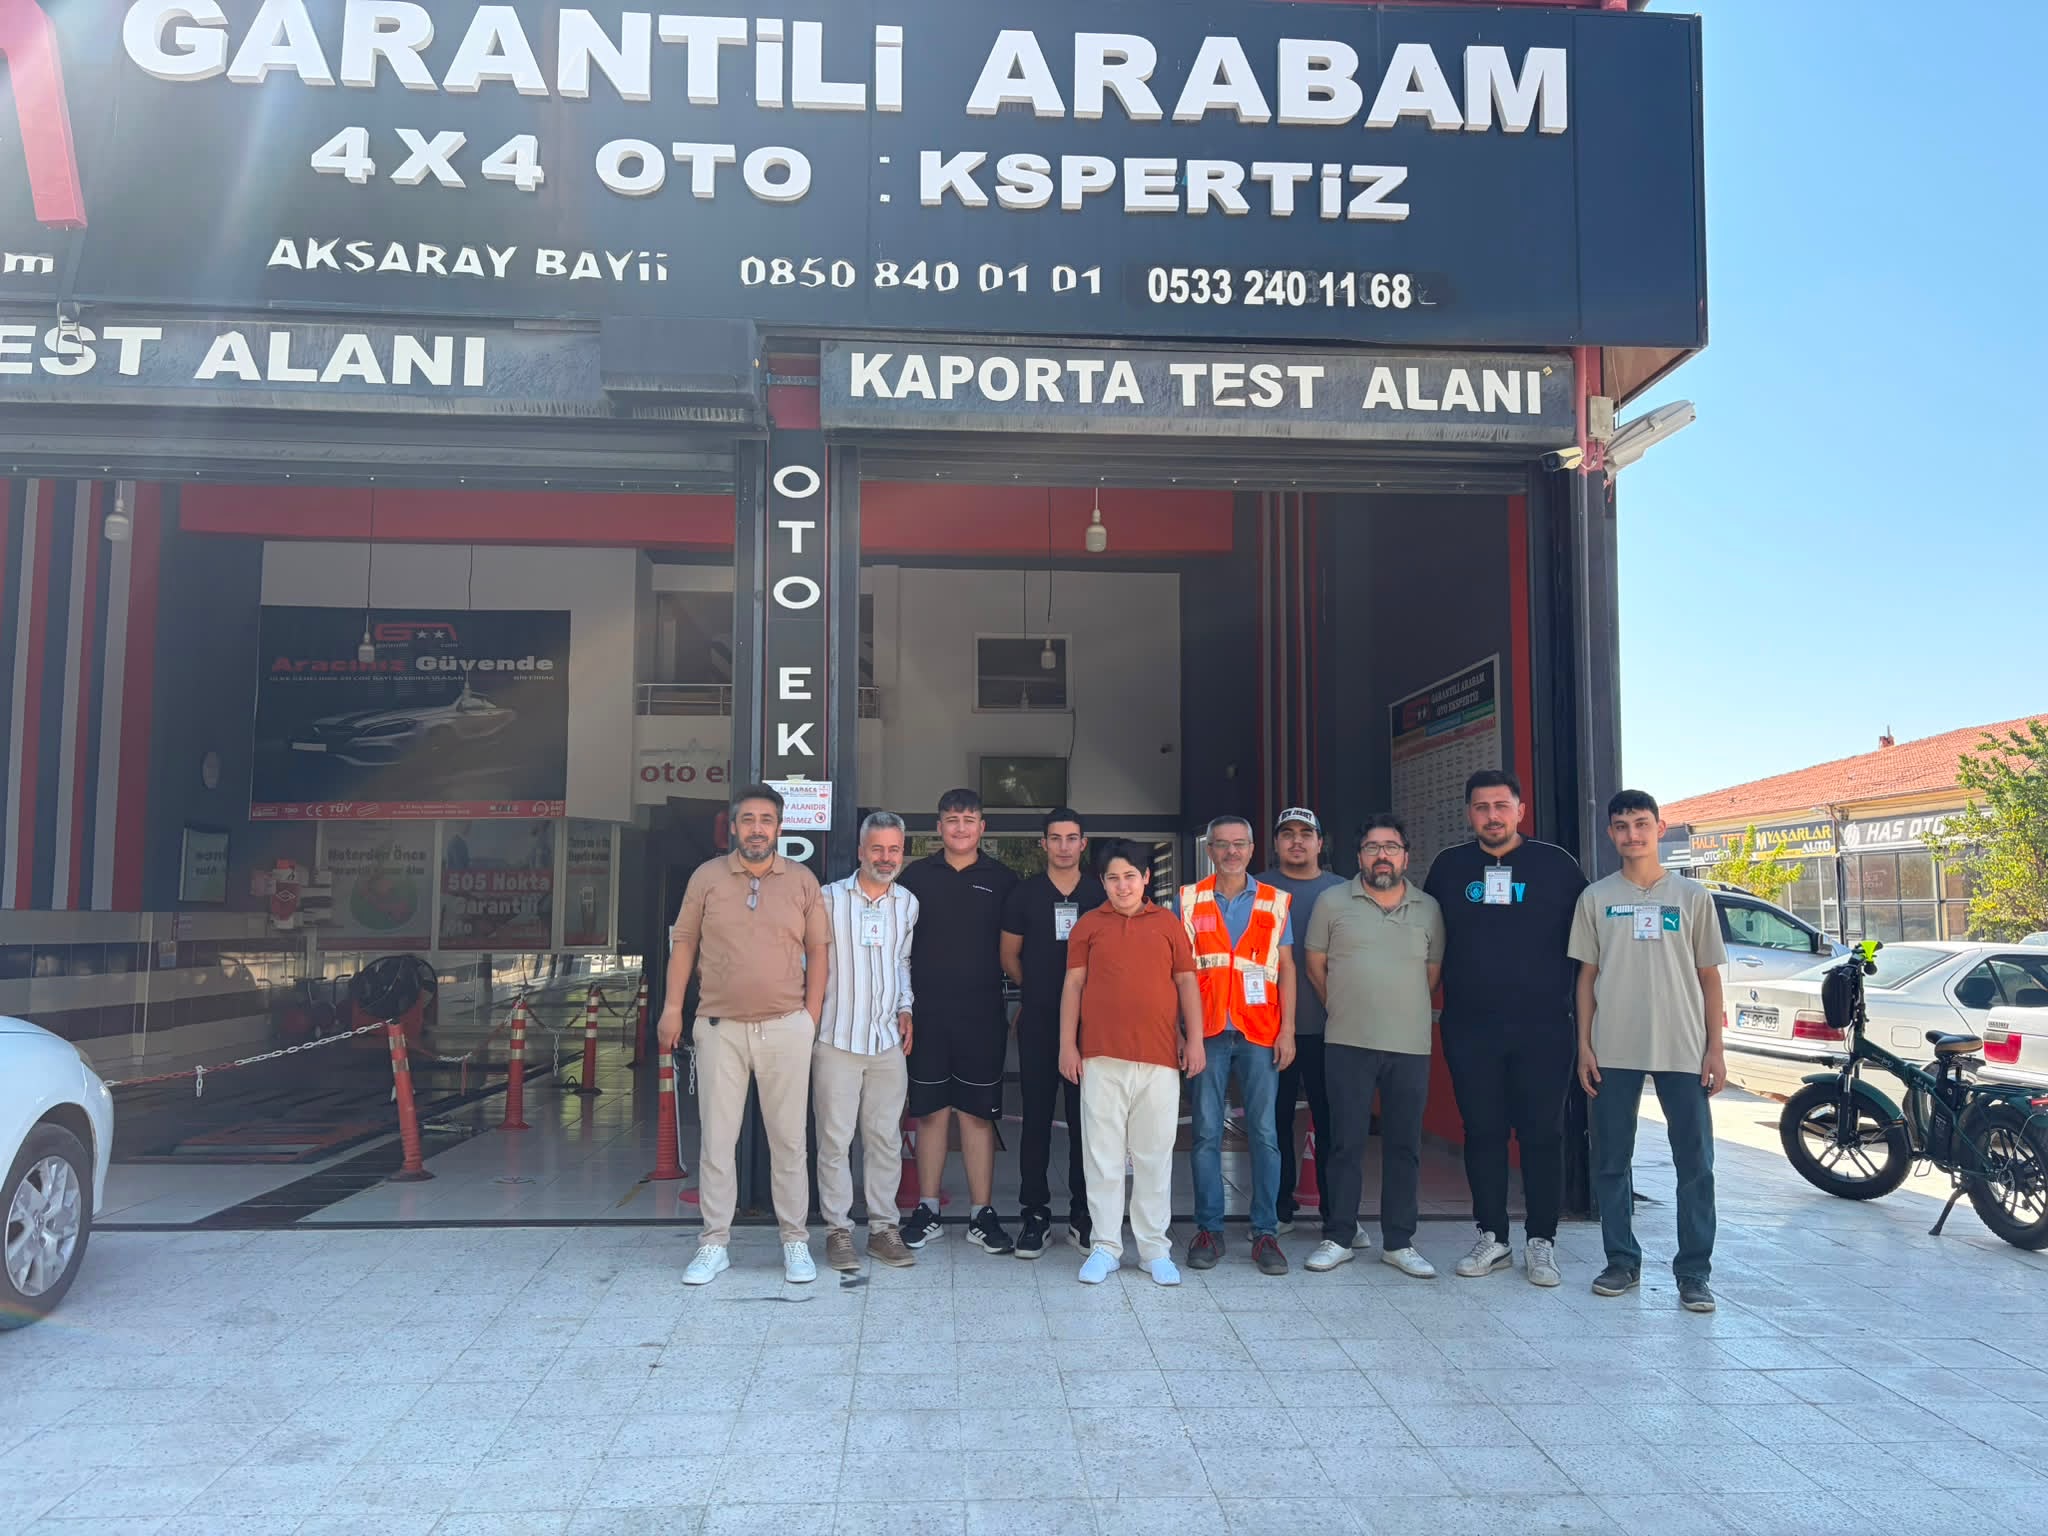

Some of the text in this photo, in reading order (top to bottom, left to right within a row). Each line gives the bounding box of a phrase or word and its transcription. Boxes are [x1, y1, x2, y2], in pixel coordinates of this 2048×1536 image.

[966, 29, 1568, 135] ARABAM
[595, 138, 813, 202] OTO
[267, 236, 518, 280] AKSARAY
[740, 256, 1103, 296] 0850 840 01 01
[1147, 267, 1412, 309] 0533 240 11 68
[195, 330, 486, 388] ALANI
[850, 352, 1543, 416] KAPORTA TEST ALANI
[772, 464, 821, 610] OTO
[415, 655, 554, 671] Güvende
[639, 762, 697, 783] oto
[1865, 821, 1904, 842] HAS
[1496, 882, 1504, 892] 1
[871, 924, 878, 935] 4
[1065, 918, 1072, 930] 3
[1644, 917, 1653, 927] 2
